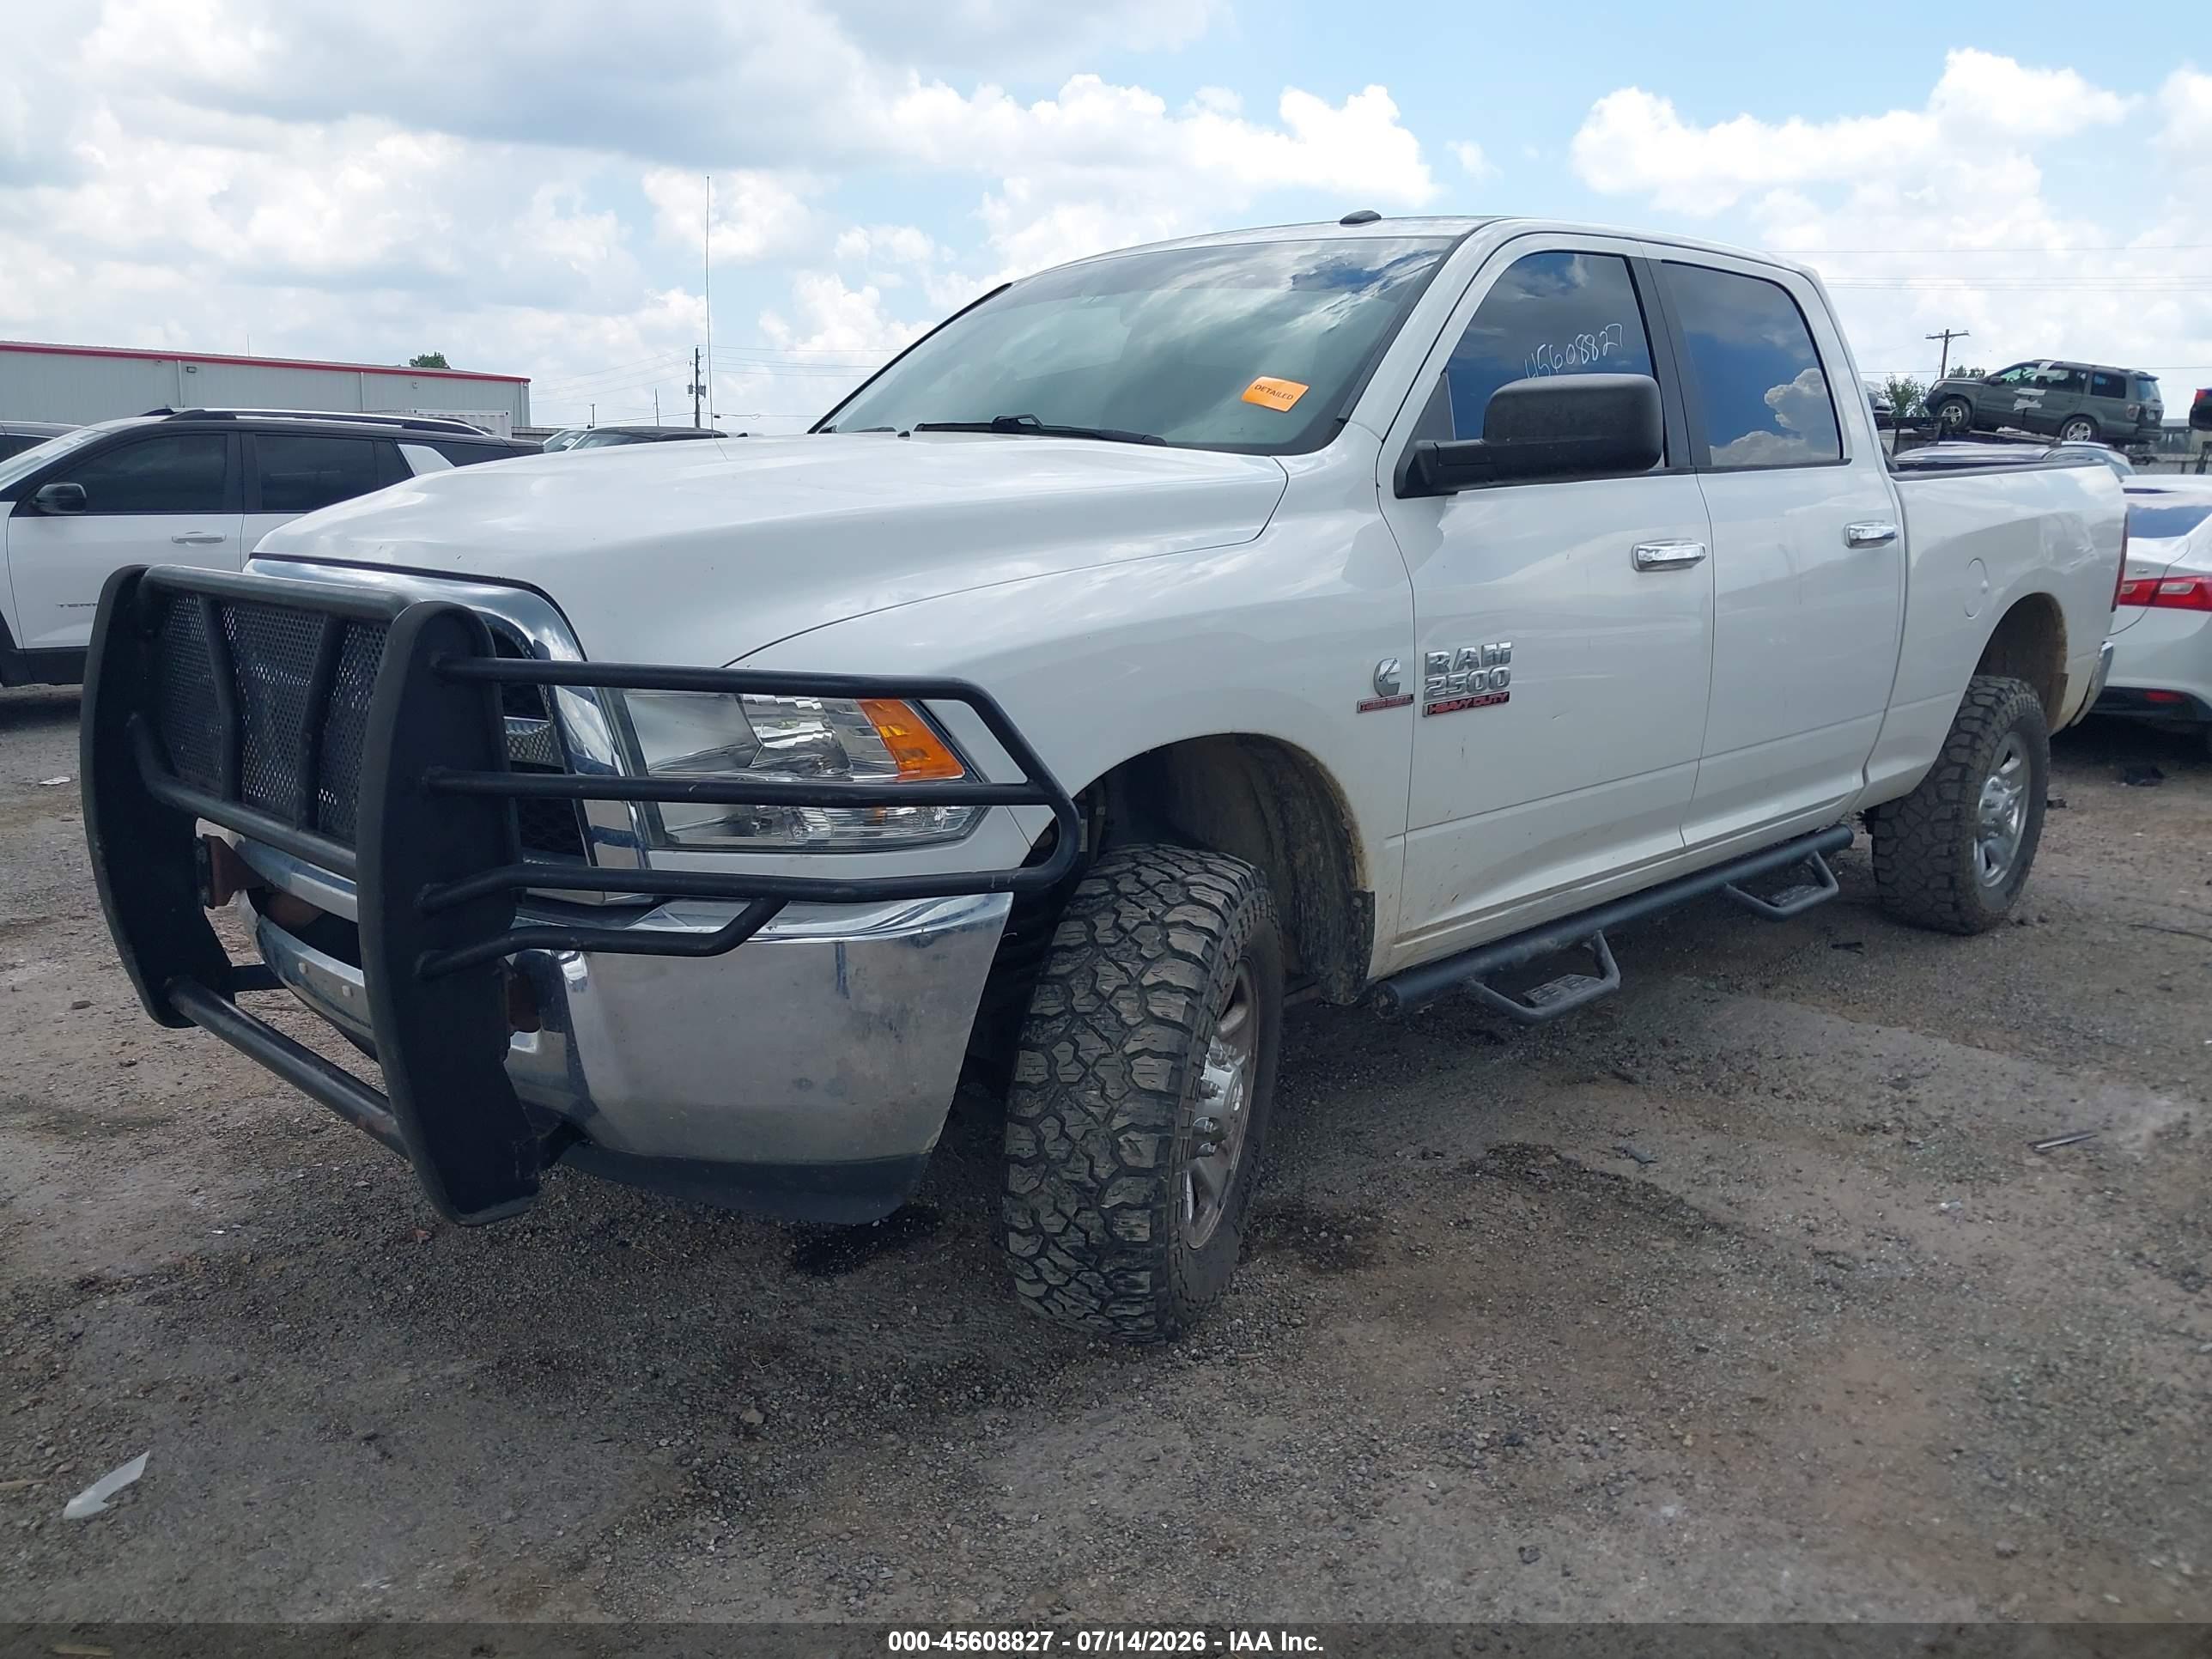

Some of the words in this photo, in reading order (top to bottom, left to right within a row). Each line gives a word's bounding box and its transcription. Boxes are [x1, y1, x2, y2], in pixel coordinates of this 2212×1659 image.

[1524, 323, 1623, 378] 45608827
[1254, 384, 1294, 400] DETAILED
[1425, 641, 1511, 676] RAM
[1424, 665, 1511, 701] 2500
[1428, 698, 1473, 714] HEAVY
[1473, 693, 1509, 708] DUTY
